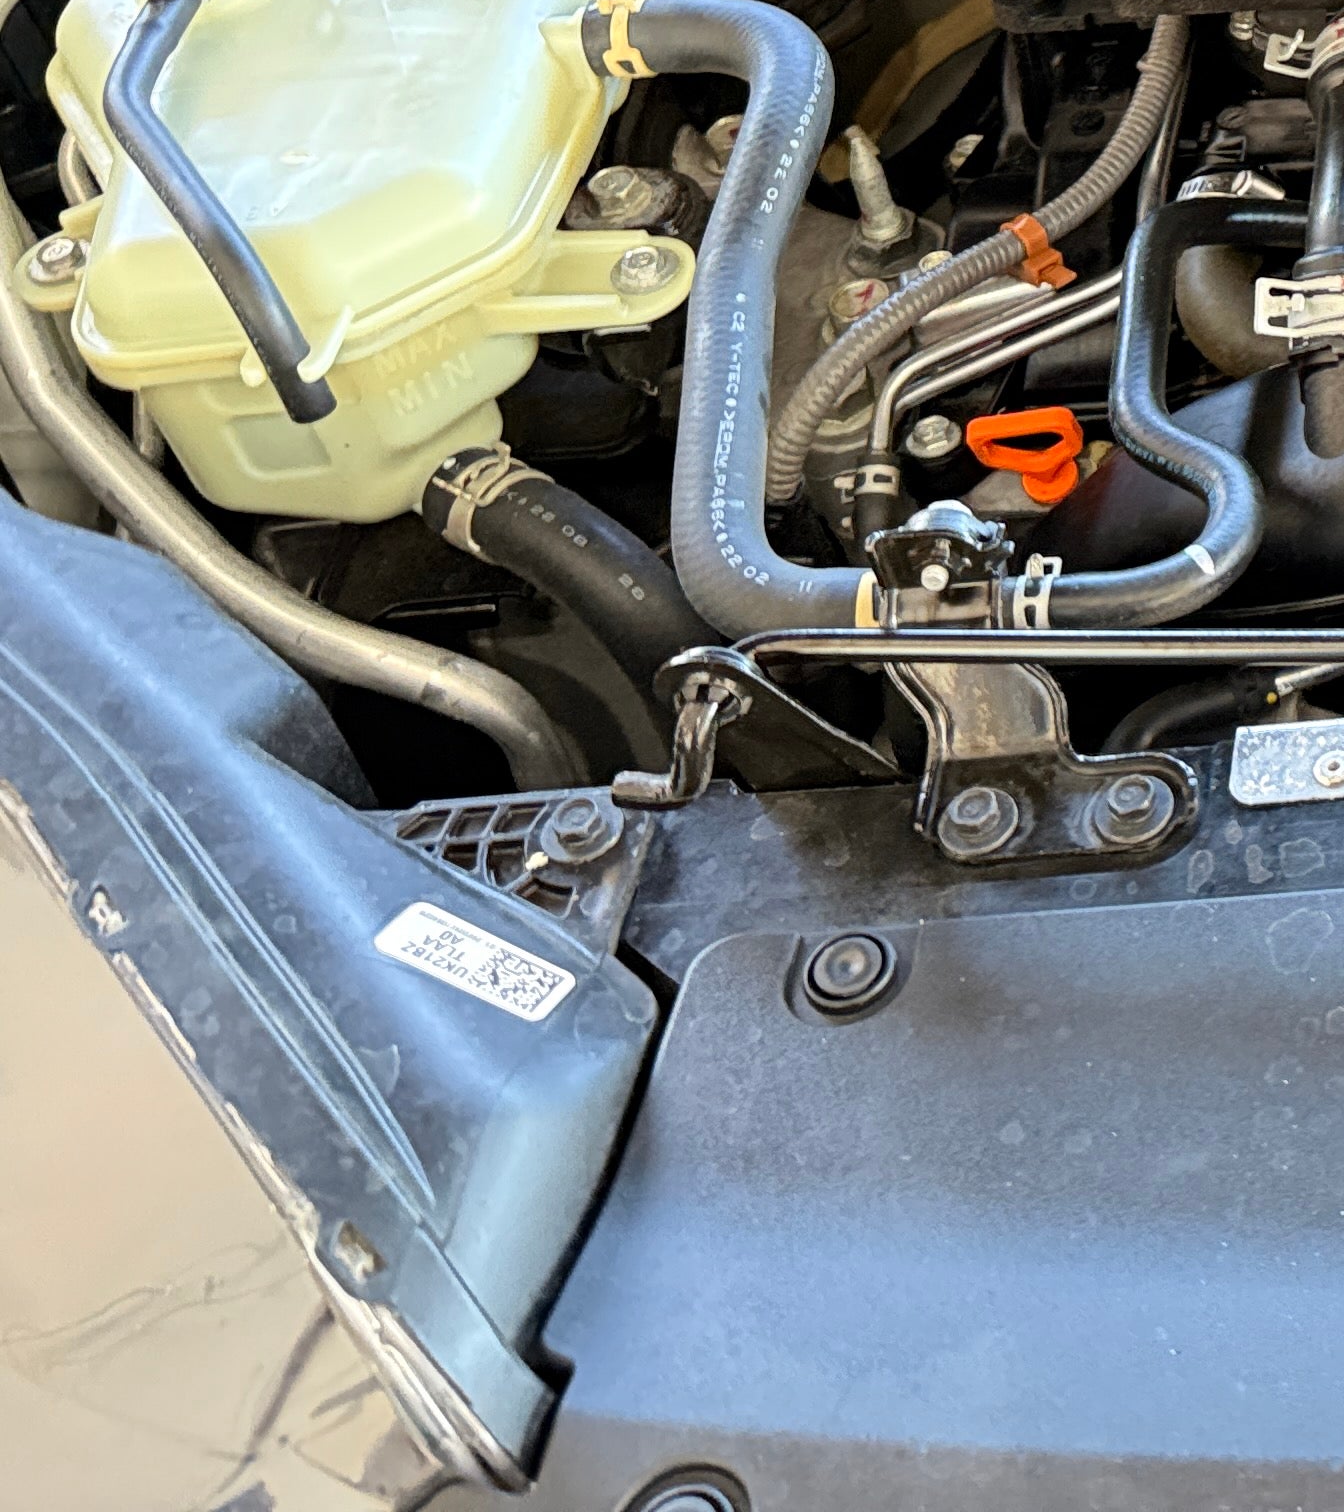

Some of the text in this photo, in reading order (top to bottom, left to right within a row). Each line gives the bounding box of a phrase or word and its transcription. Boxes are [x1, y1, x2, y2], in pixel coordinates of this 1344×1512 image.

[760, 190, 779, 214] 02
[729, 311, 745, 332] C2
[725, 342, 743, 396] Y-TEC
[387, 352, 473, 416] MIN
[718, 546, 744, 570] 22
[742, 564, 771, 588] 02
[422, 935, 465, 961] TLAA
